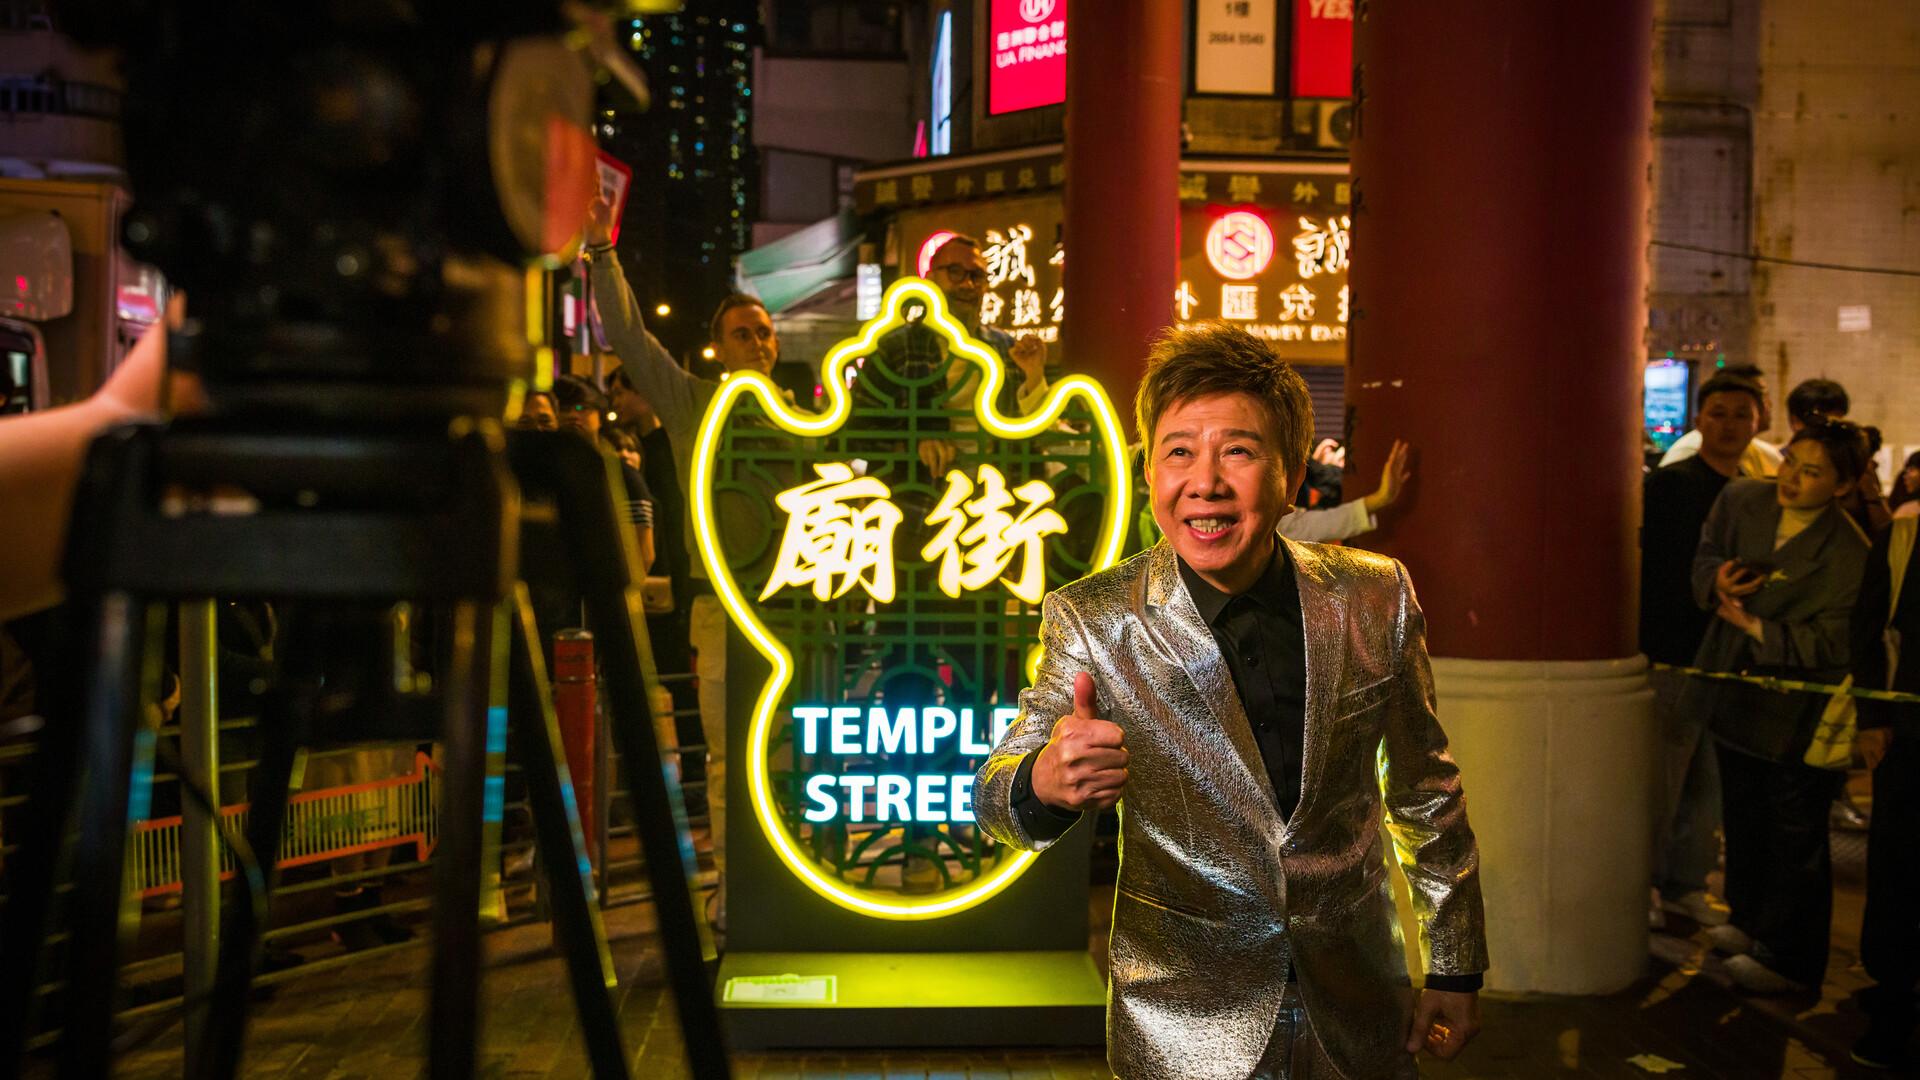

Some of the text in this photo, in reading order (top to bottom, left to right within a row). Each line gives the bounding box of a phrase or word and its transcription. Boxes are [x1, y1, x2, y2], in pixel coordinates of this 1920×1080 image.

[996, 39, 1067, 69] UA FINANC
[997, 20, 1065, 51] 亞洲聯合財
[758, 461, 1069, 604] 廟街
[805, 774, 978, 823] STREE
